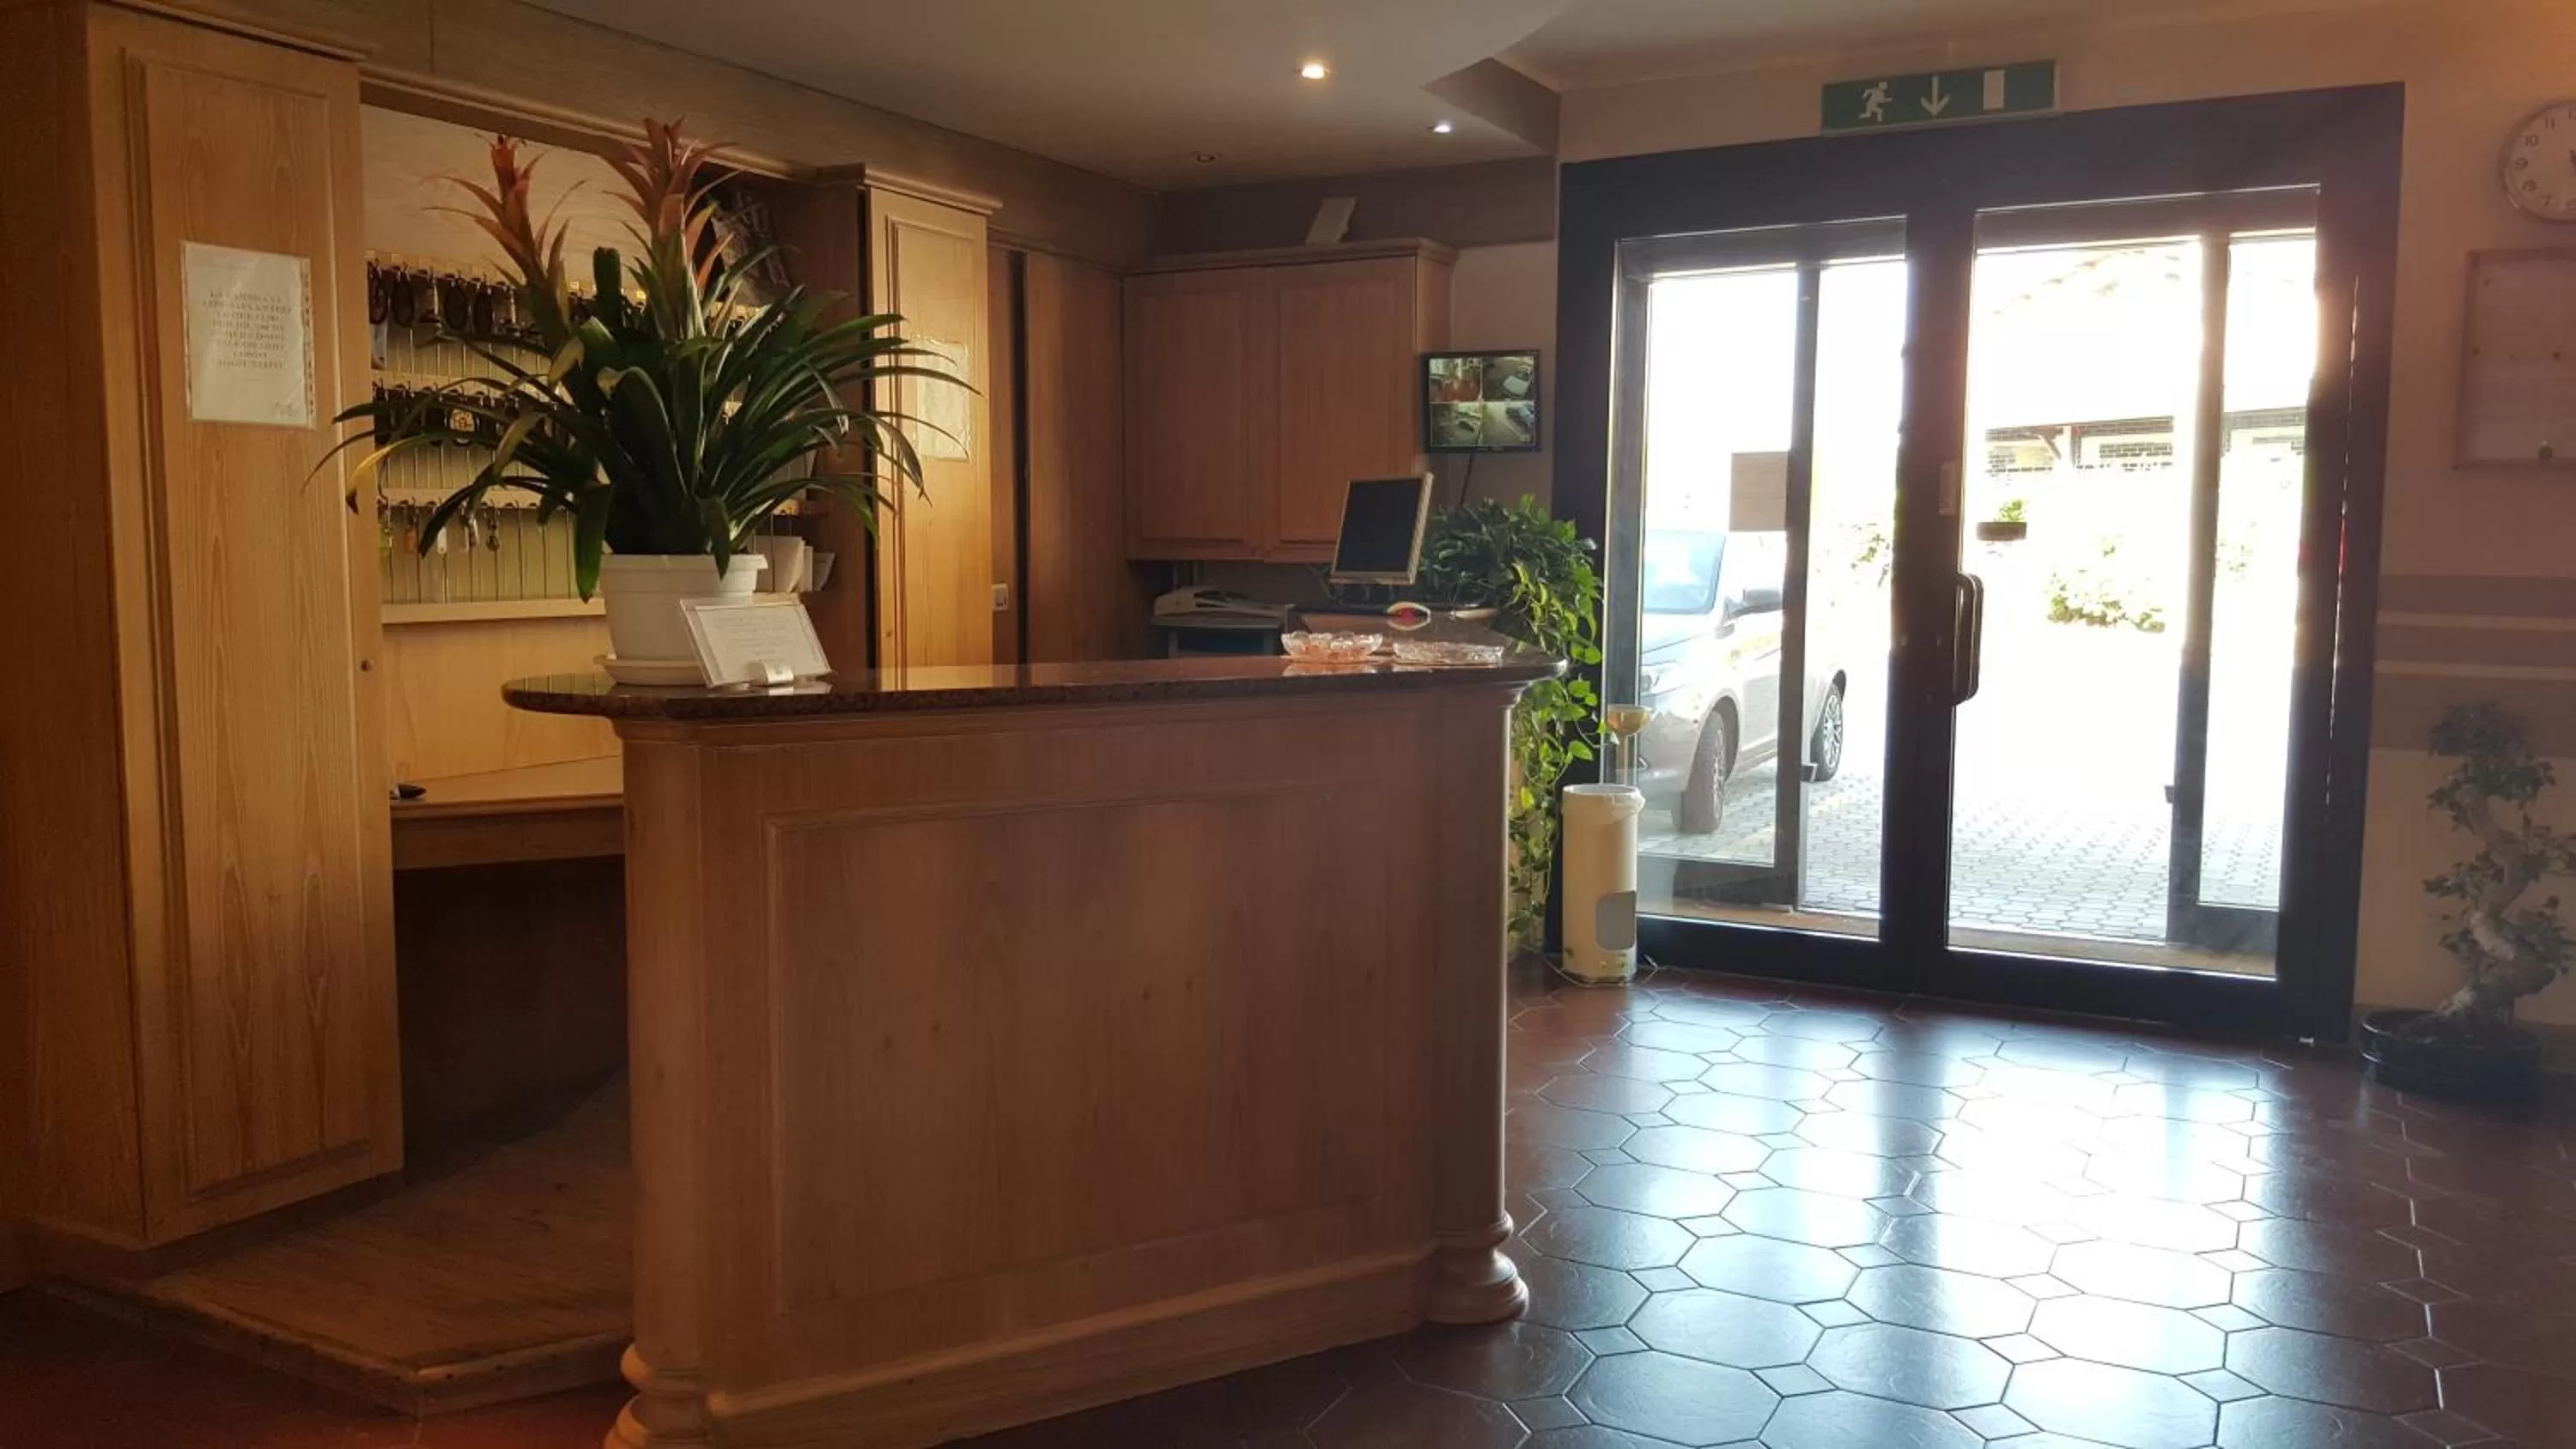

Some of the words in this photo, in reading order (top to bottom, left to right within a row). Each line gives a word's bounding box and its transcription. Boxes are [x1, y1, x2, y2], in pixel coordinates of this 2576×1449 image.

[2544, 118, 2555, 130] 11
[2524, 134, 2539, 148] 10
[2514, 158, 2529, 171] 9
[2541, 195, 2554, 208] 7
